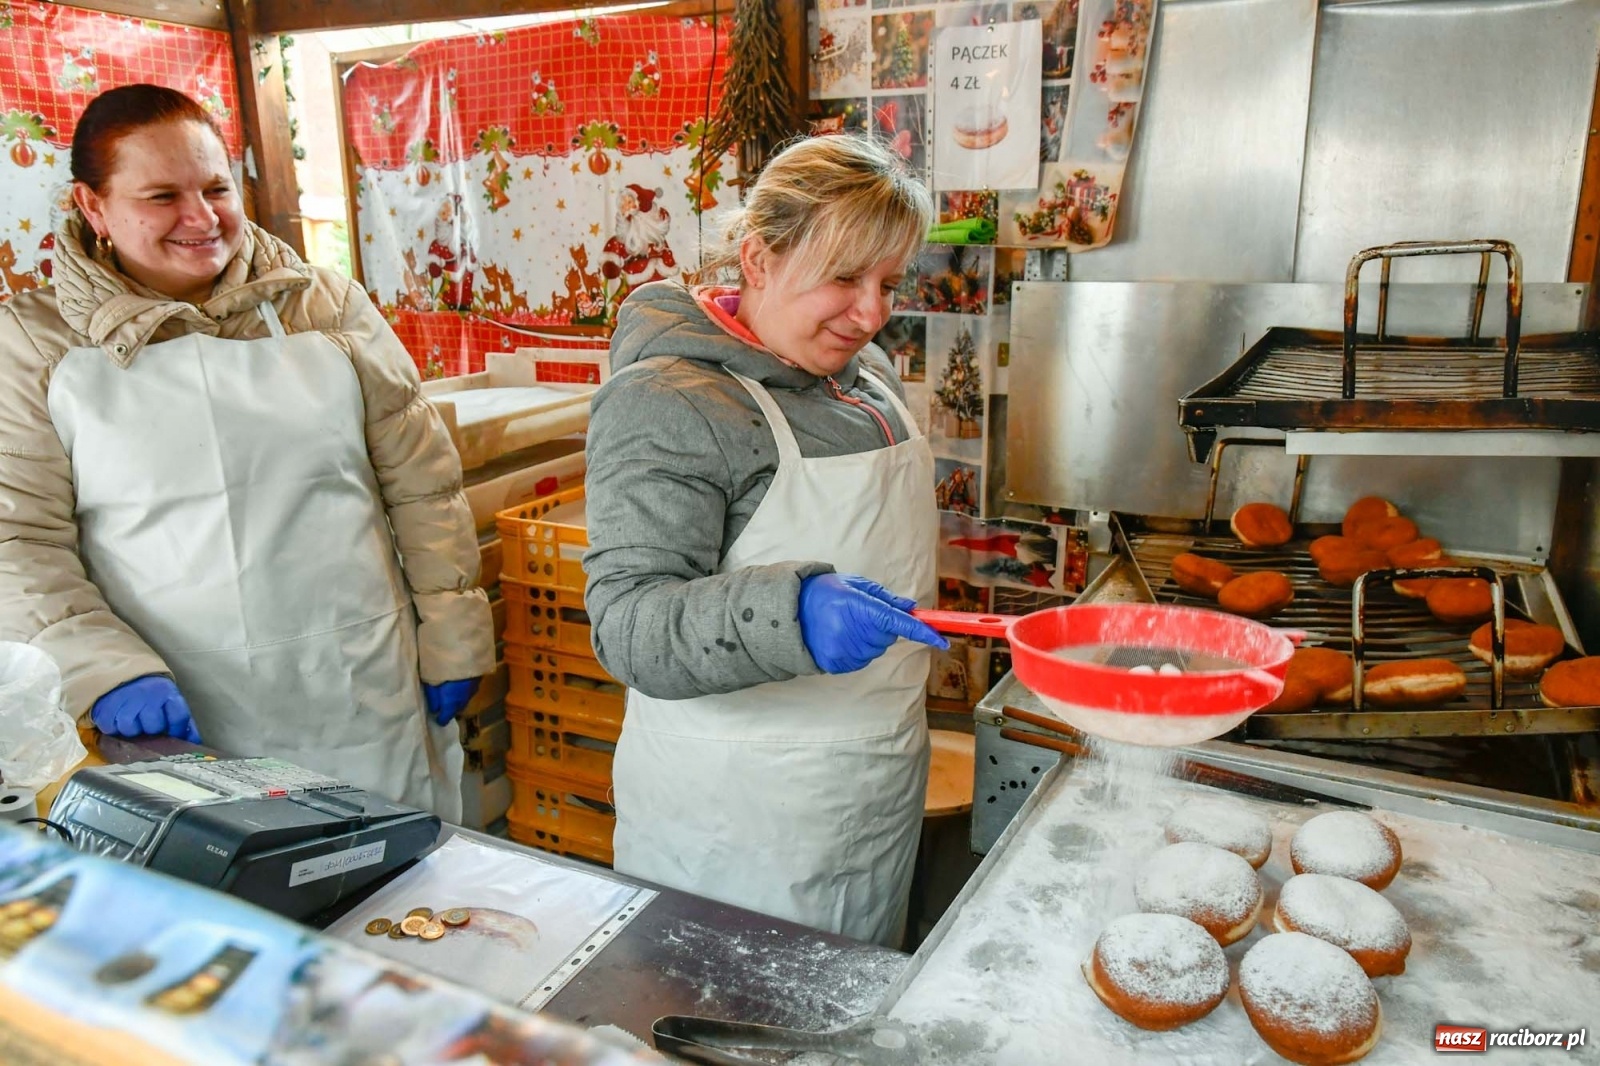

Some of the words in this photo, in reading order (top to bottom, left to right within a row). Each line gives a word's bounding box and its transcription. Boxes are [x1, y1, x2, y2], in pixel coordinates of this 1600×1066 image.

[951, 44, 1008, 64] PĄCZEK
[950, 76, 960, 90] 4
[964, 76, 981, 90] ZŁ
